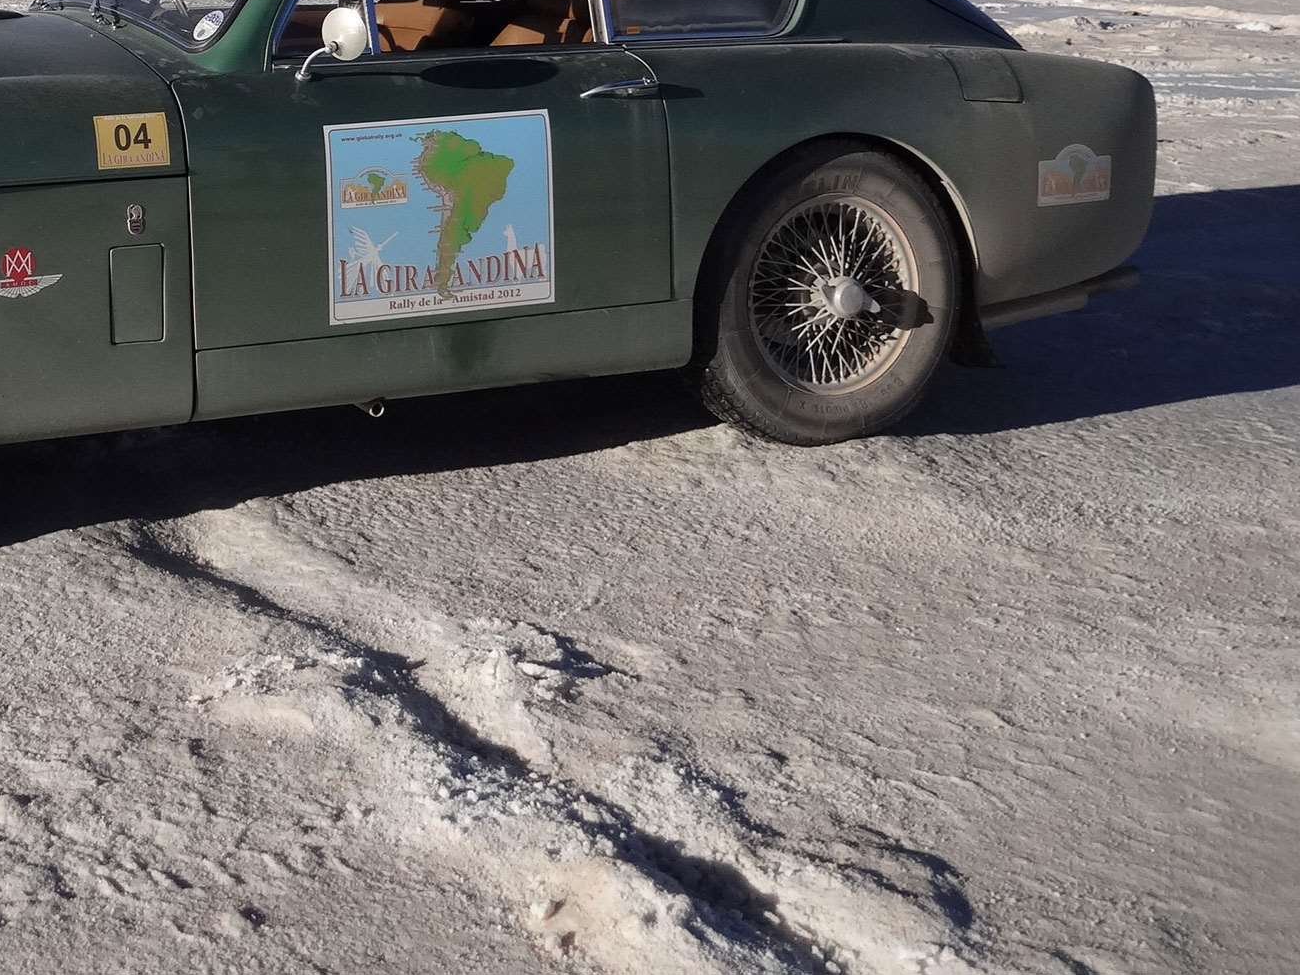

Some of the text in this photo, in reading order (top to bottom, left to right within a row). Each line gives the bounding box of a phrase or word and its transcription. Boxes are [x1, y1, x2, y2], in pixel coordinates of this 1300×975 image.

[114, 122, 152, 151] 04
[340, 242, 545, 297] LA GIRA ANDINA
[389, 288, 522, 310] Rally de la Amistad 2012
